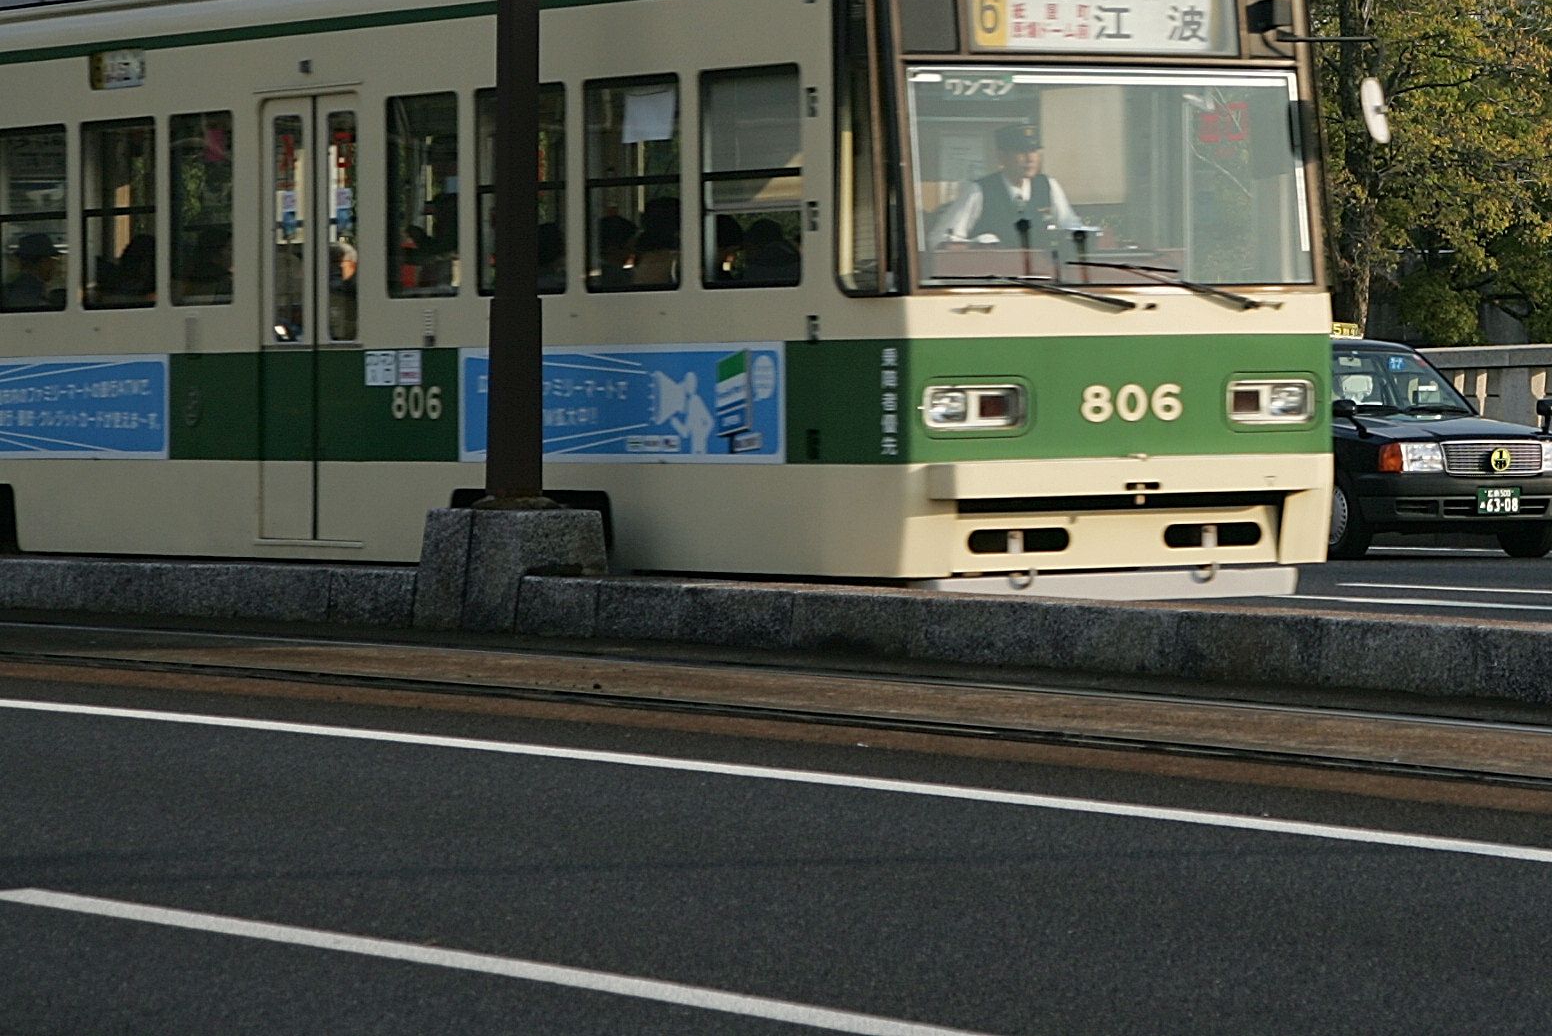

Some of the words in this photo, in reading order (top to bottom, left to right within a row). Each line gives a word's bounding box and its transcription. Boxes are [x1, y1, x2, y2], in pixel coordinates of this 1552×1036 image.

[1093, 5, 1207, 42] 江波
[944, 78, 1015, 96] ワンマン
[392, 386, 442, 420] 806
[1080, 384, 1183, 423] 806
[1486, 497, 1519, 513] 63-08
